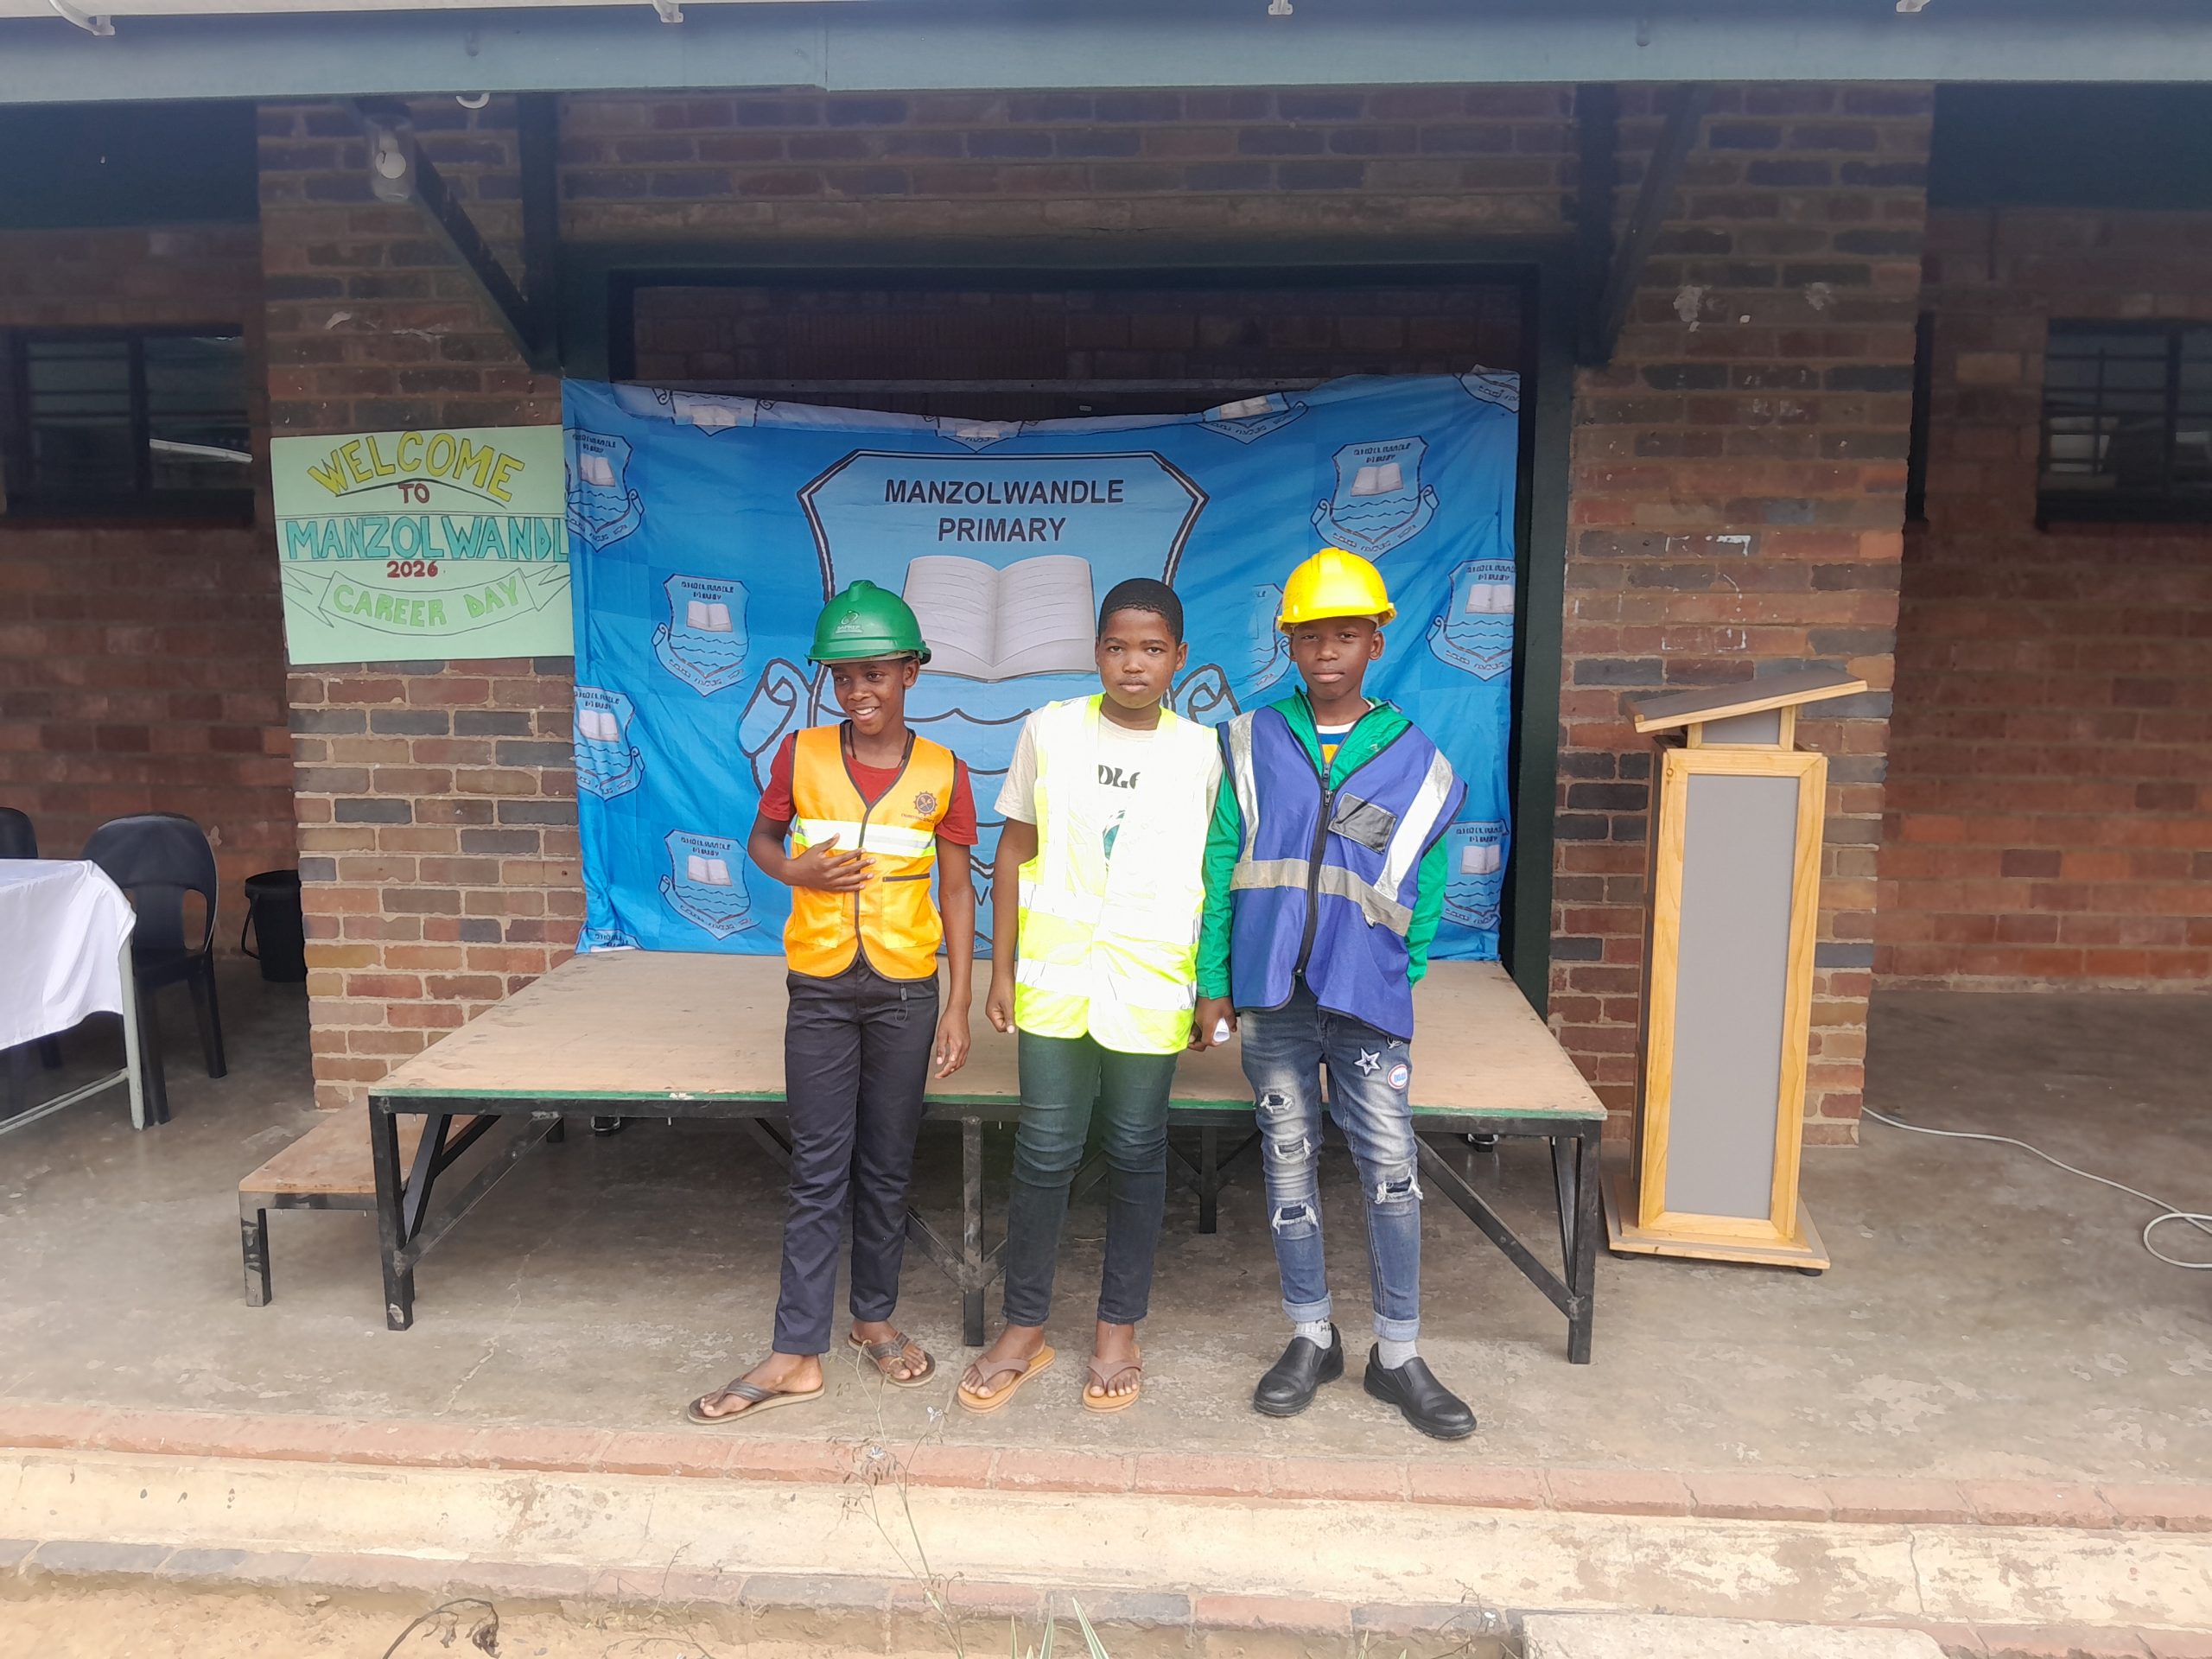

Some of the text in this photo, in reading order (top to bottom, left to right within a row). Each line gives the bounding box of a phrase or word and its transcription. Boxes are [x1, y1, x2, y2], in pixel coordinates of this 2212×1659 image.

[307, 431, 525, 502] WELCOME
[397, 482, 430, 504] TO
[884, 479, 1124, 505] MANZOLWANDLE
[938, 517, 1067, 542] PRIMARY
[386, 560, 438, 578] 2026
[333, 575, 519, 627] CAREER DAY
